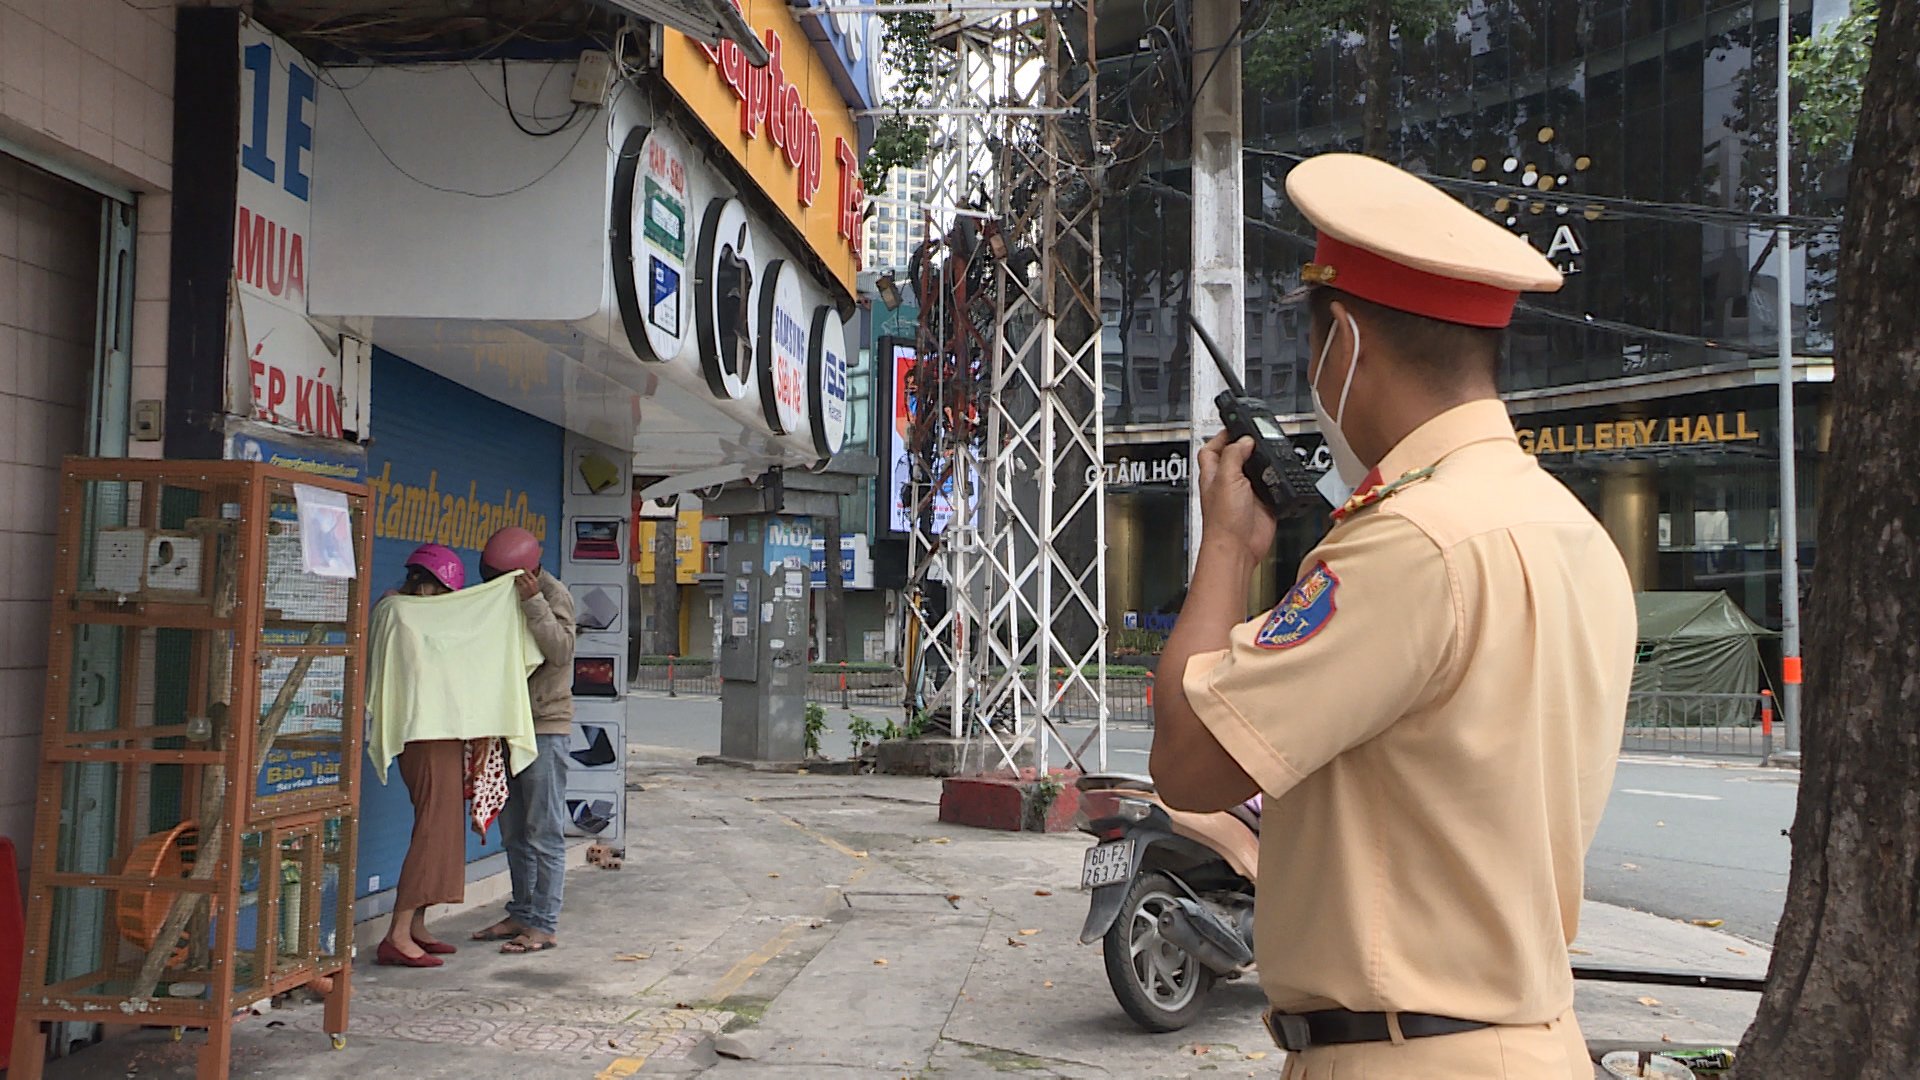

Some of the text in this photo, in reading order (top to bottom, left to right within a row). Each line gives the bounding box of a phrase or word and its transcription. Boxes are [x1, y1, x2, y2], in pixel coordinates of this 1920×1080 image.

[242, 42, 315, 201] 1E
[237, 206, 304, 300] MUA
[1518, 411, 1760, 454] GALLERY HALL
[1152, 452, 1188, 487] HỘI
